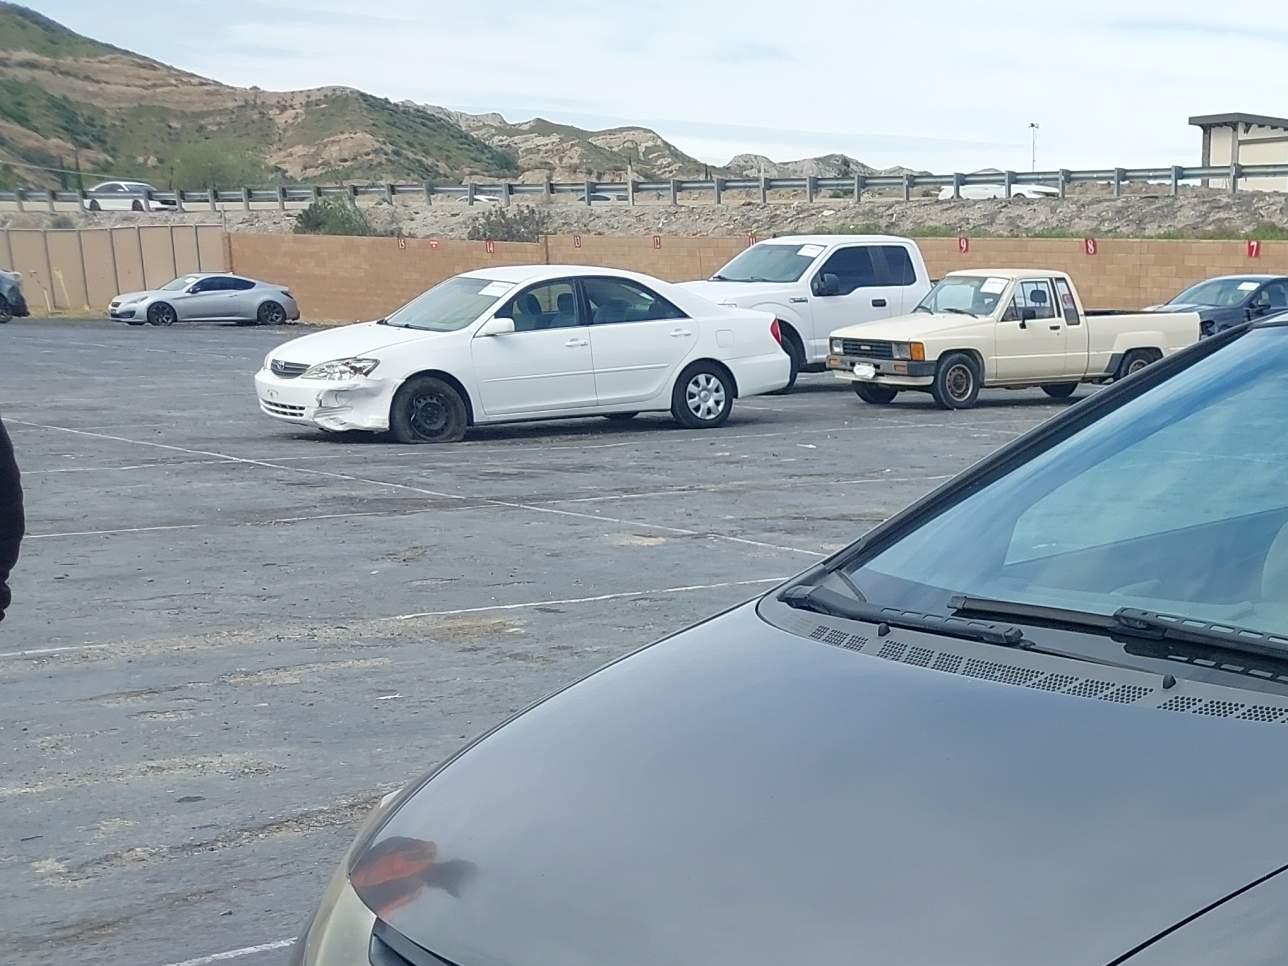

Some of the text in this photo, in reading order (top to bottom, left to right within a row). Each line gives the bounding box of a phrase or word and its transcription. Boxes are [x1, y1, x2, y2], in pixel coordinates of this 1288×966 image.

[486, 240, 494, 253] 14
[960, 238, 967, 253] 9
[1086, 239, 1094, 254] 8
[1249, 240, 1258, 257] 7
